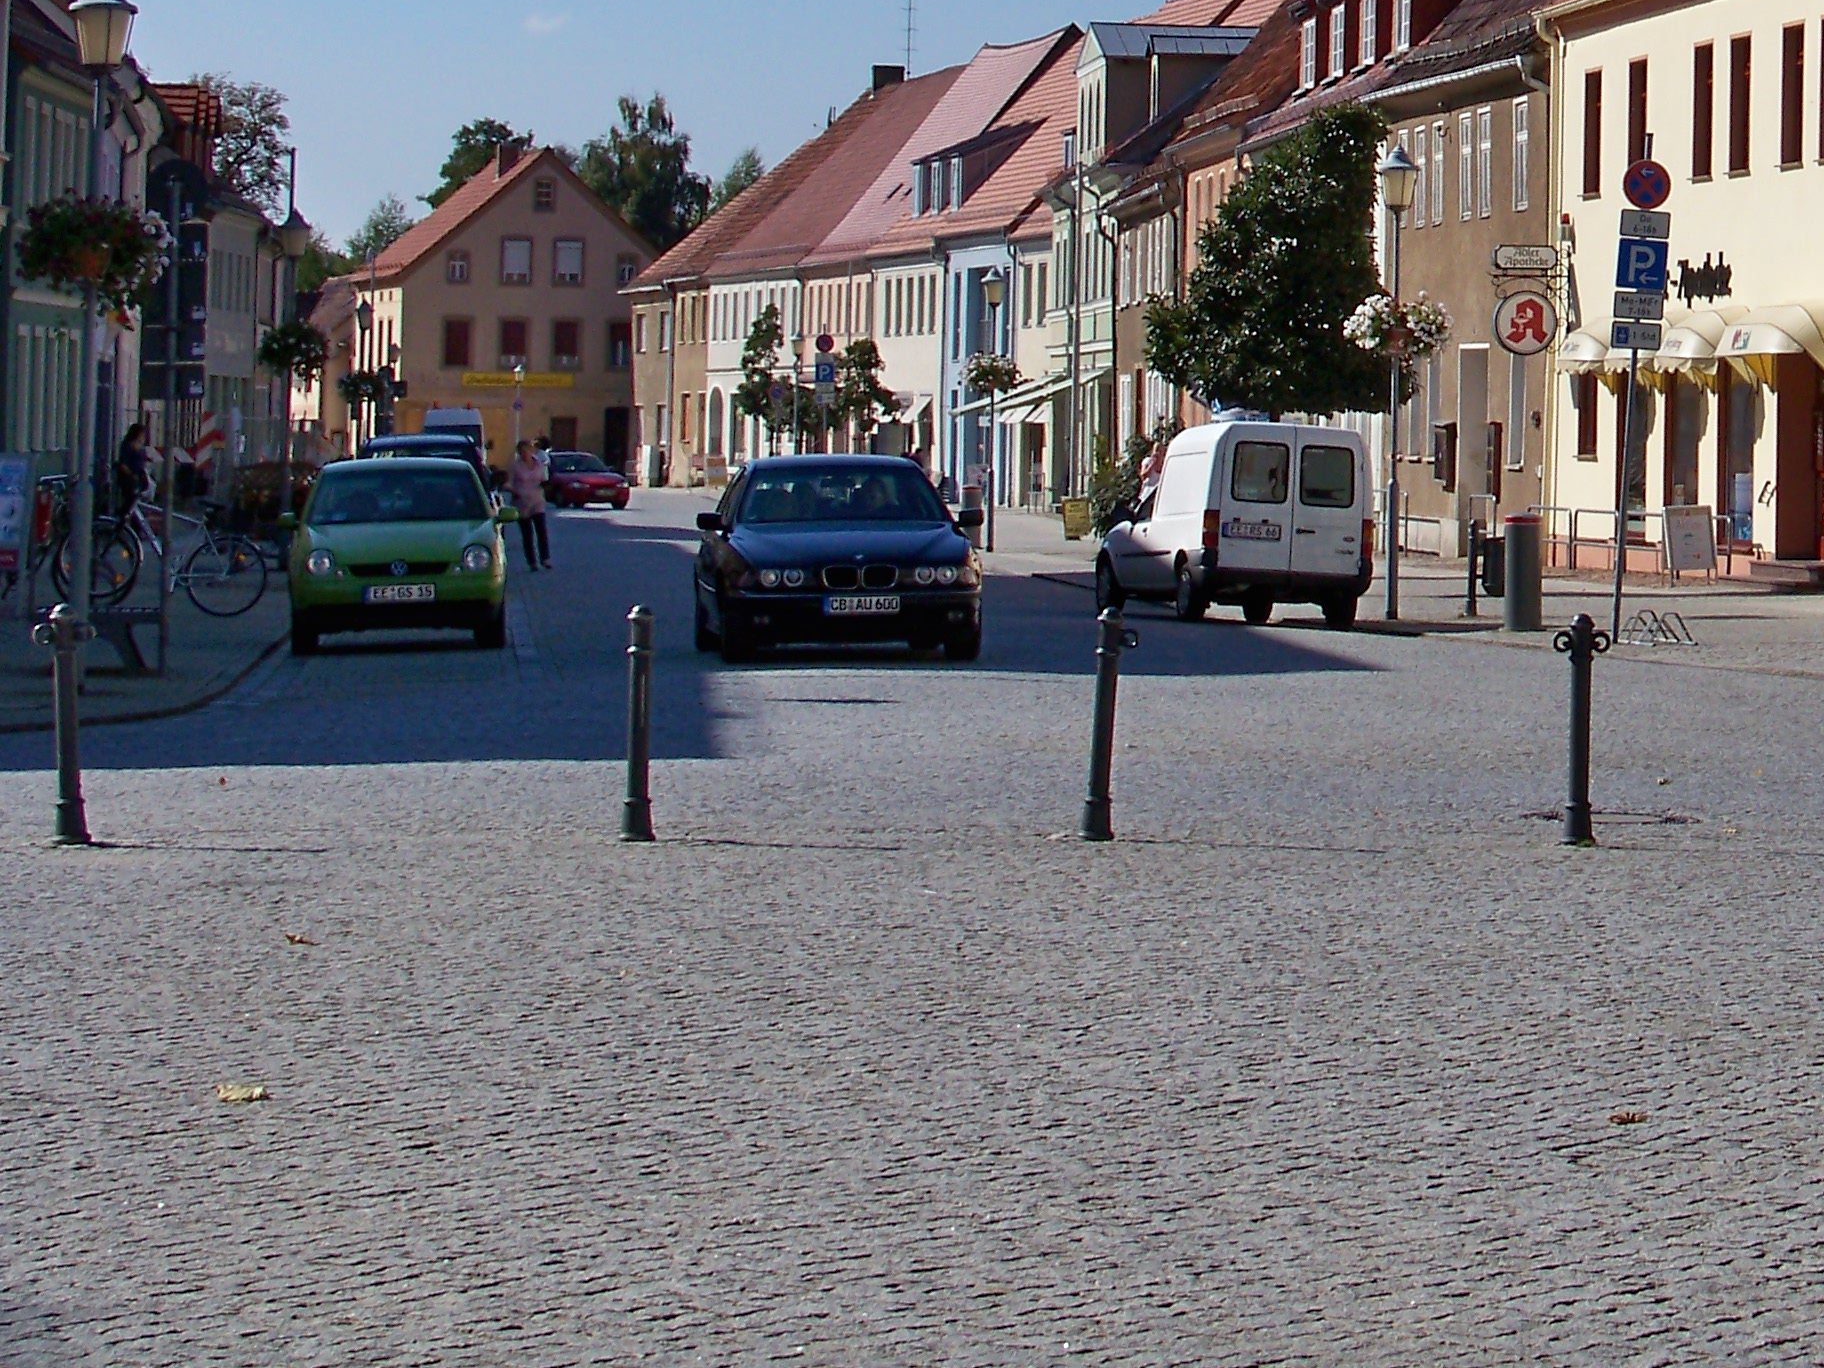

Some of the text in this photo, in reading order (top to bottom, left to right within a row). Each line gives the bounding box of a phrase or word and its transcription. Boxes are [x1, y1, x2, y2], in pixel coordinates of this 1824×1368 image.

[1504, 256, 1549, 268] Apotheke
[1628, 245, 1656, 283] P
[831, 598, 899, 611] CB AU 600
